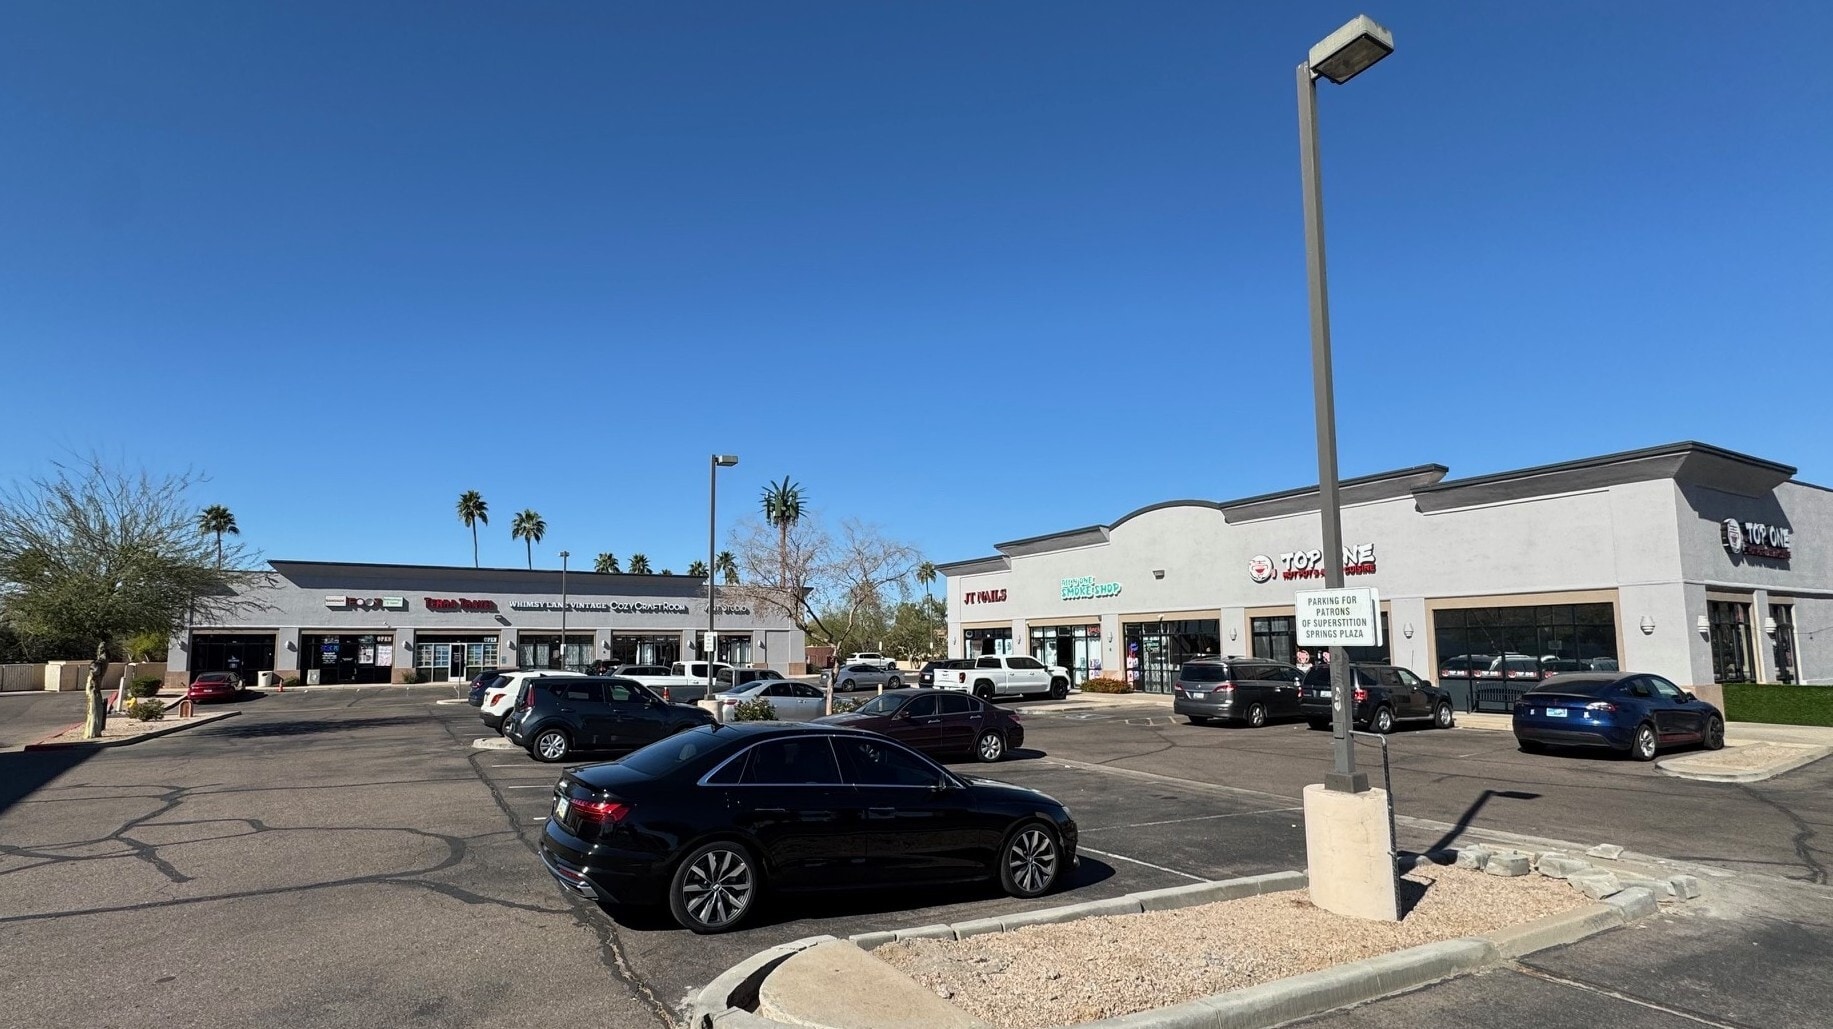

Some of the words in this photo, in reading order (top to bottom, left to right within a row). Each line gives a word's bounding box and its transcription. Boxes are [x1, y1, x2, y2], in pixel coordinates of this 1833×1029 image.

[1745, 522, 1767, 545] TOP
[1769, 525, 1791, 548] ONE
[1280, 549, 1321, 571] TOP
[1342, 543, 1376, 565] NE
[1343, 563, 1376, 576] CUISINE
[1061, 585, 1092, 598] SMOKE
[1094, 582, 1120, 595] SHOP
[964, 592, 976, 606] JT
[977, 588, 1007, 604] NAILS
[1307, 596, 1340, 606] PARKING
[1341, 595, 1357, 605] FOR
[610, 601, 634, 611] COZY
[634, 601, 662, 611] CRAFT
[663, 602, 687, 611] ROOM
[1316, 607, 1350, 616] PATRONS
[1301, 619, 1311, 628] OF
[1313, 618, 1367, 627] SUPERSTITION
[1306, 629, 1337, 638] SPRINGS
[1339, 629, 1364, 638] PLAZA
